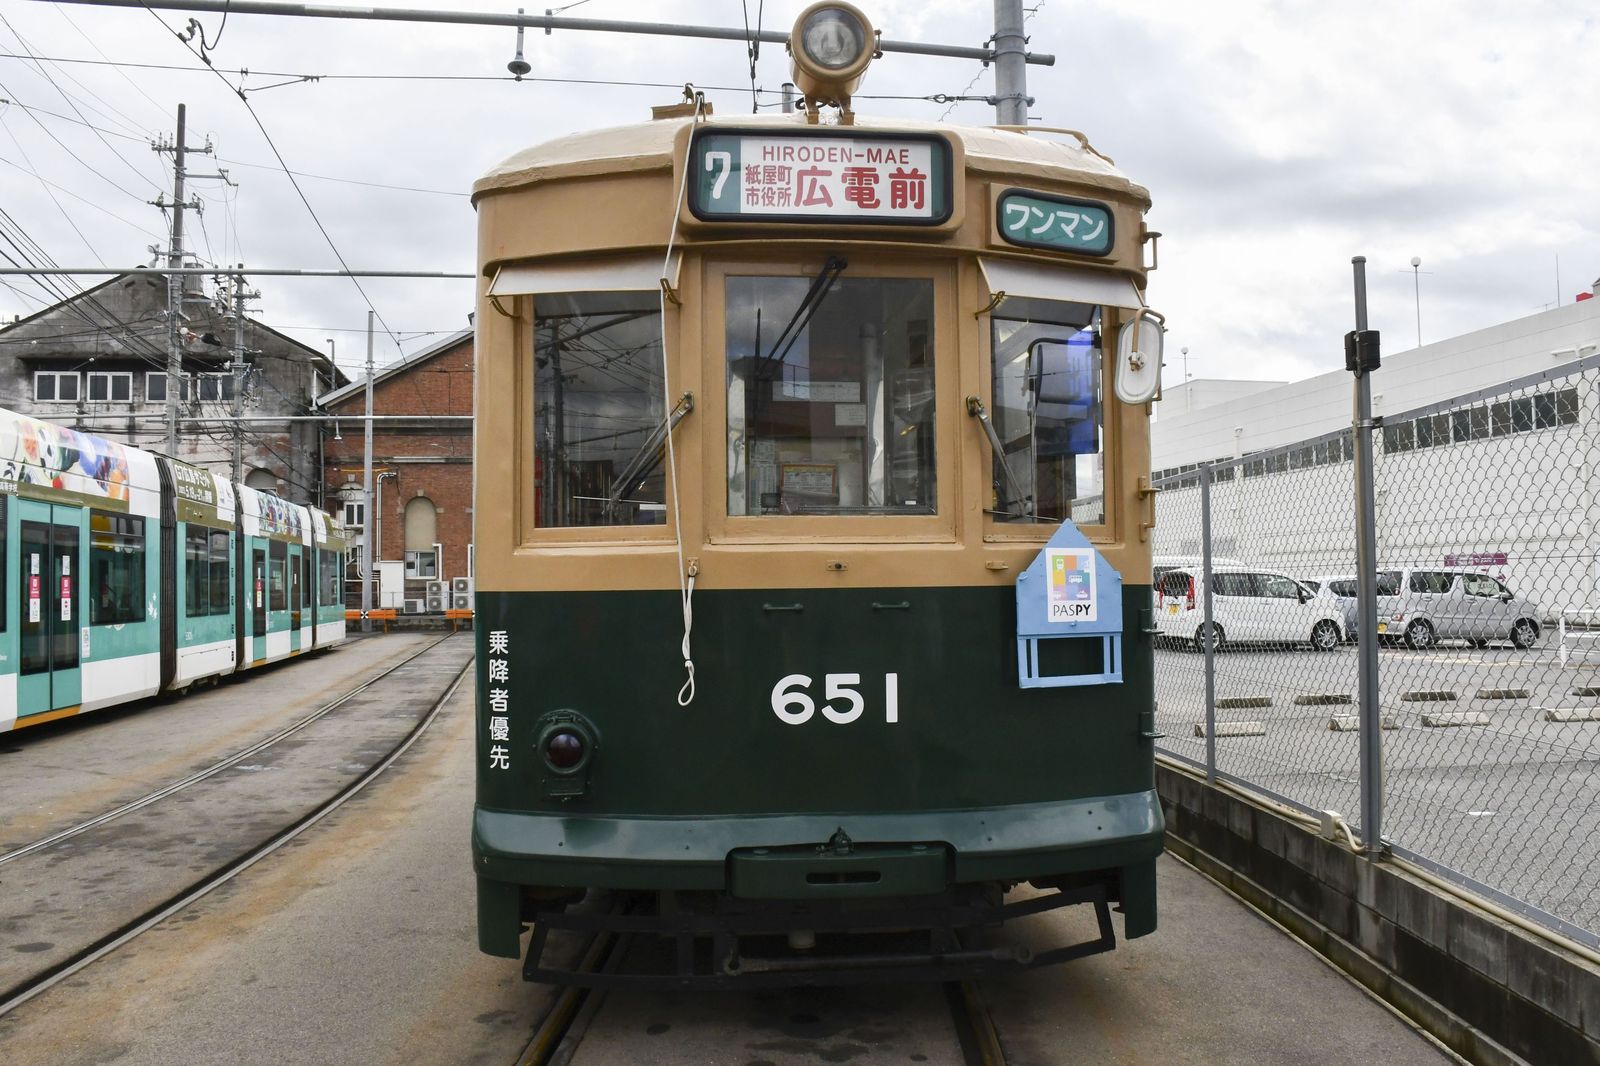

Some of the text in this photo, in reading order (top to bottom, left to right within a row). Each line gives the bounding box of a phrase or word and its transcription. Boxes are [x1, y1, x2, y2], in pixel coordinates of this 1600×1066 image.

[763, 146, 910, 164] HIRODEN-MAE
[705, 151, 731, 199] 7
[745, 164, 792, 185] 紙屋町
[794, 165, 927, 209] 広電前
[745, 186, 792, 207] 市役所
[1006, 203, 1104, 241] ワンマン
[1053, 604, 1091, 616] PASPY
[489, 630, 510, 770] 乗降者優先
[771, 673, 898, 725] 651
